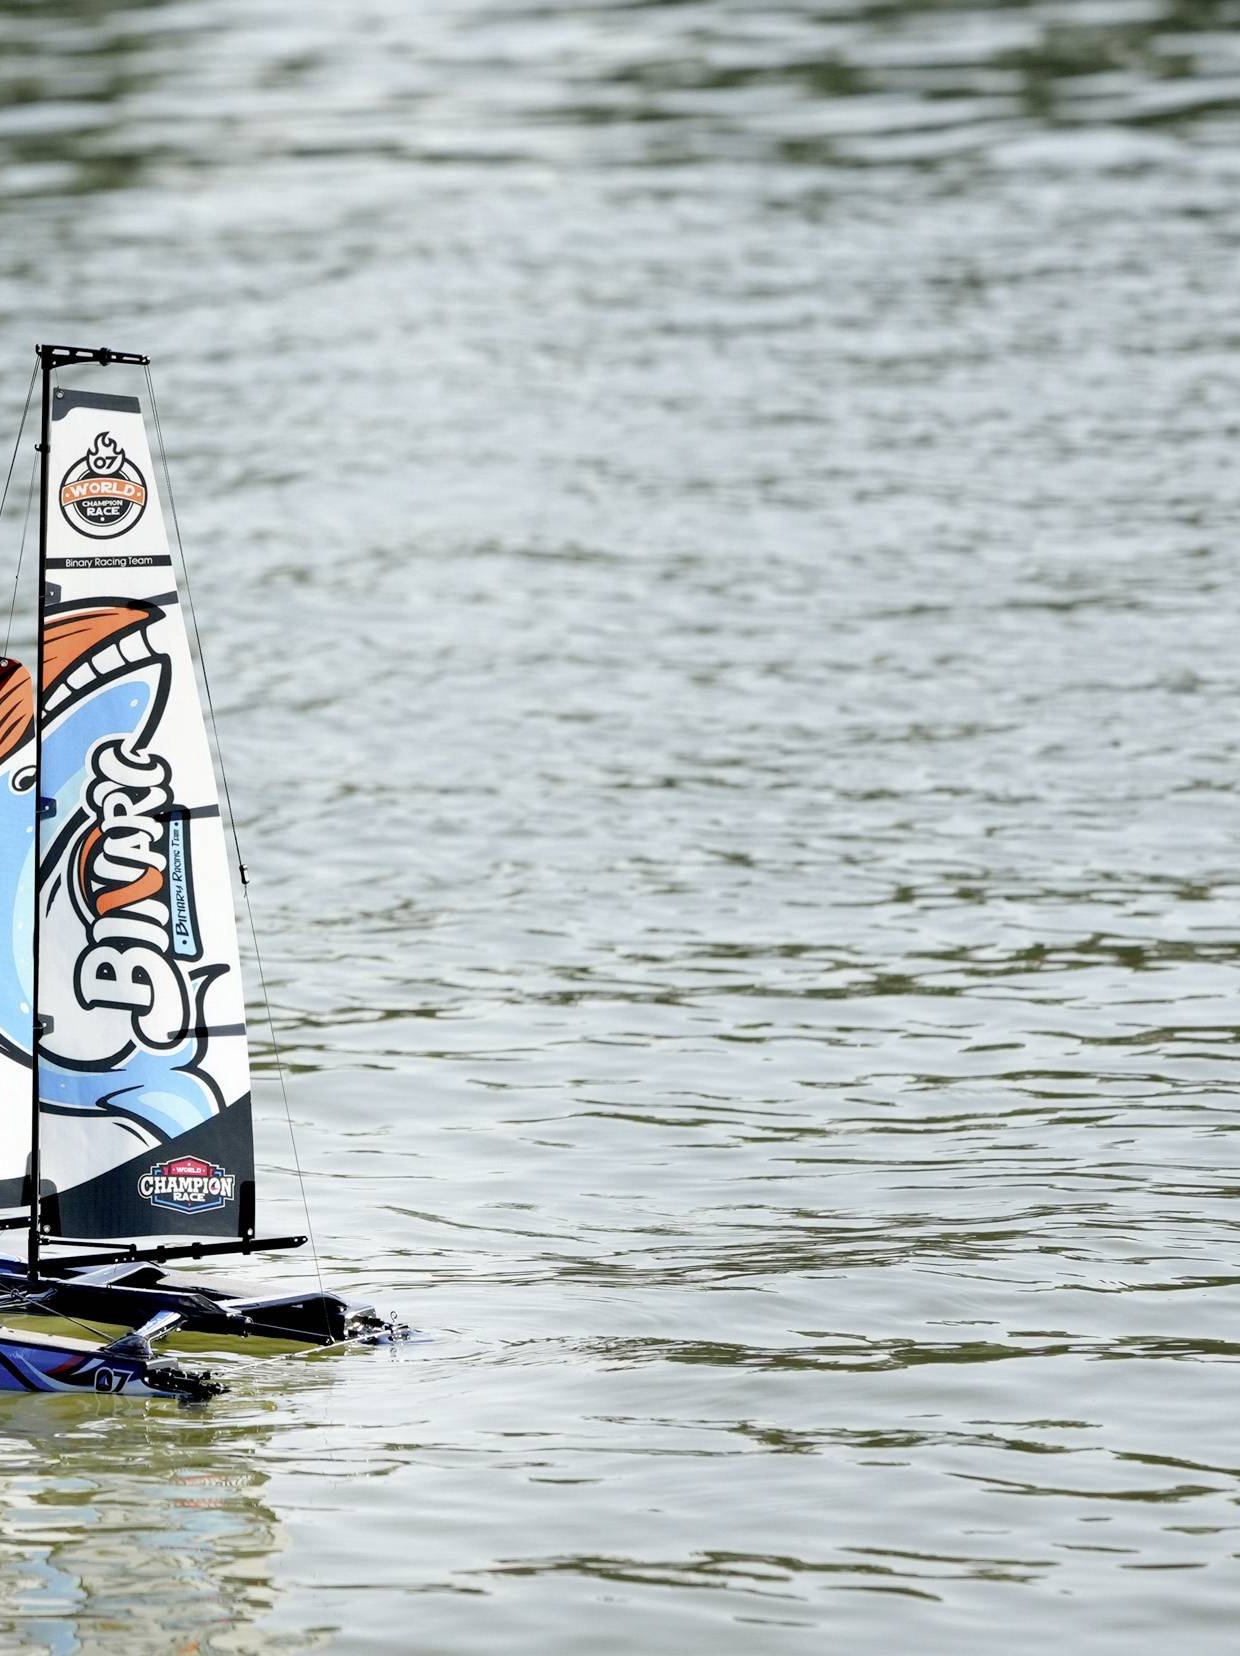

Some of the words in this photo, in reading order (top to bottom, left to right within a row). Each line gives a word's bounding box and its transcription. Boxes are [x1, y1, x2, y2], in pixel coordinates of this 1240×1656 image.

[93, 456, 118, 470] 07
[70, 481, 136, 498] WORLD
[86, 507, 120, 516] RACE
[65, 558, 93, 568] Binary
[94, 557, 127, 567] Racing
[128, 556, 153, 565] Team
[140, 1176, 233, 1197] CHAMPION
[173, 1192, 206, 1202] RACE
